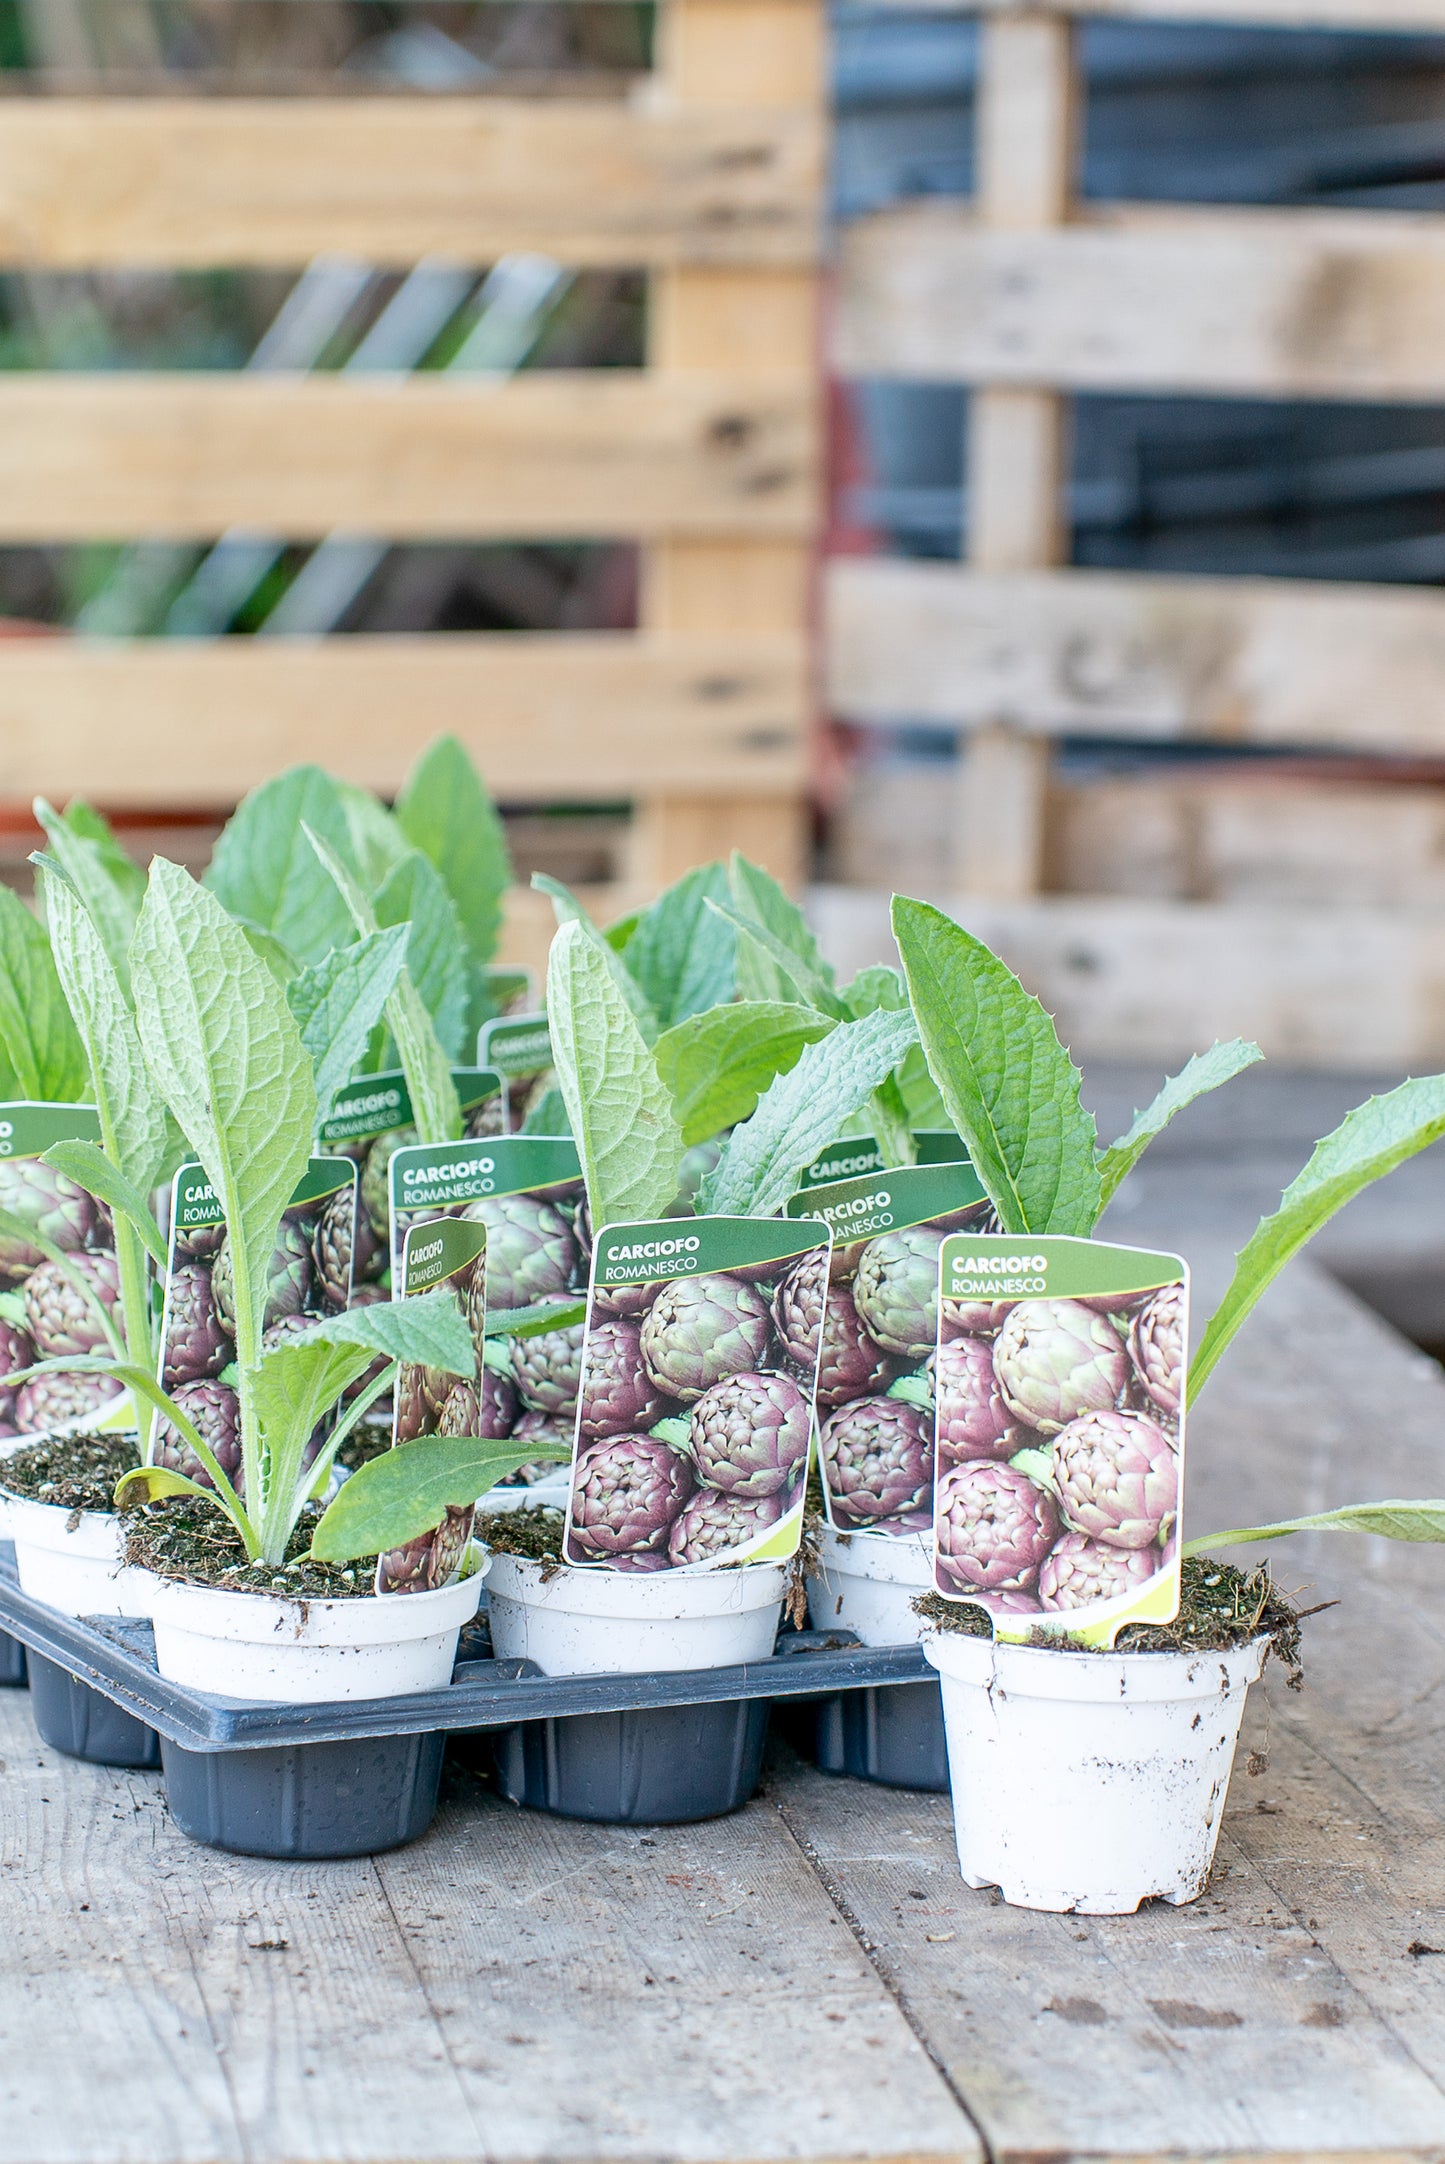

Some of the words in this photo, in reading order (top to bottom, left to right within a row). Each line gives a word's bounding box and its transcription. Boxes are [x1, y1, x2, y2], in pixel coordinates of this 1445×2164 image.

[333, 1089, 401, 1120] ARCIOFO
[403, 1157, 495, 1185] CARCIOFO
[403, 1178, 495, 1204] ROMANESCO
[834, 1212, 893, 1240] ANESCO
[409, 1238, 444, 1266] CARCIOFO
[607, 1236, 700, 1261] CARCIOFO
[408, 1260, 443, 1286] ROMANESCO
[605, 1257, 698, 1280] ROMANESCO
[951, 1255, 1048, 1274] CARCIOFO
[951, 1277, 1047, 1294] ROMANESCO
